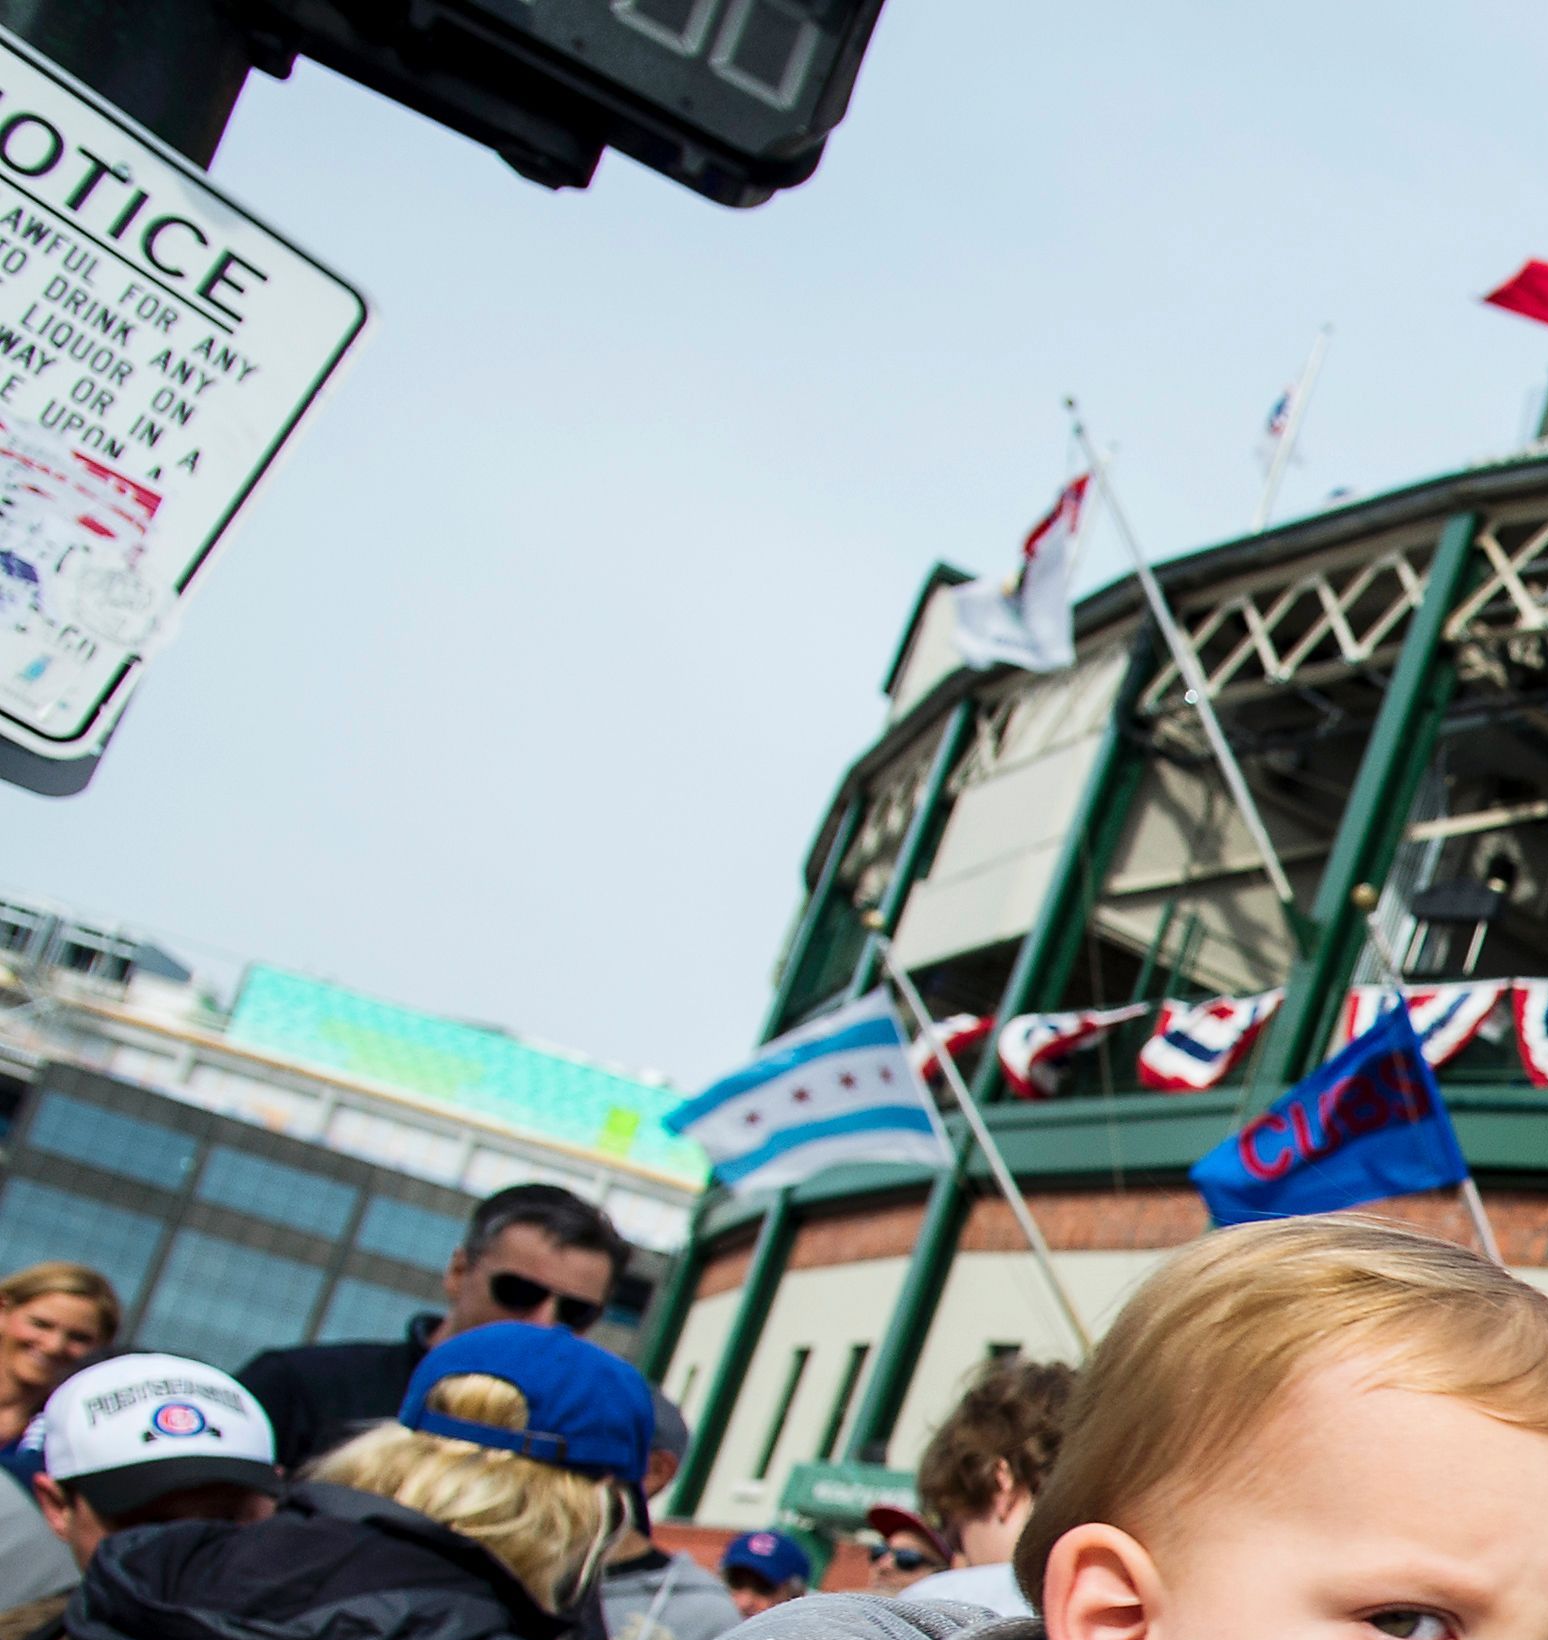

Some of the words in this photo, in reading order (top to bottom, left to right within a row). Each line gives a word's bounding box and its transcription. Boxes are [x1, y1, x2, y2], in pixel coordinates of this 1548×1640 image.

[0, 90, 268, 323] OTICE
[20, 302, 134, 386] LIQUOR
[151, 386, 195, 426] ON
[43, 275, 136, 346] DRINK
[150, 349, 215, 395] ANY
[118, 282, 179, 333] FOR
[191, 336, 256, 382] ANY
[70, 376, 115, 416] OR
[129, 415, 164, 448] IN
[177, 449, 200, 474] A
[1239, 1053, 1431, 1182] CUBS
